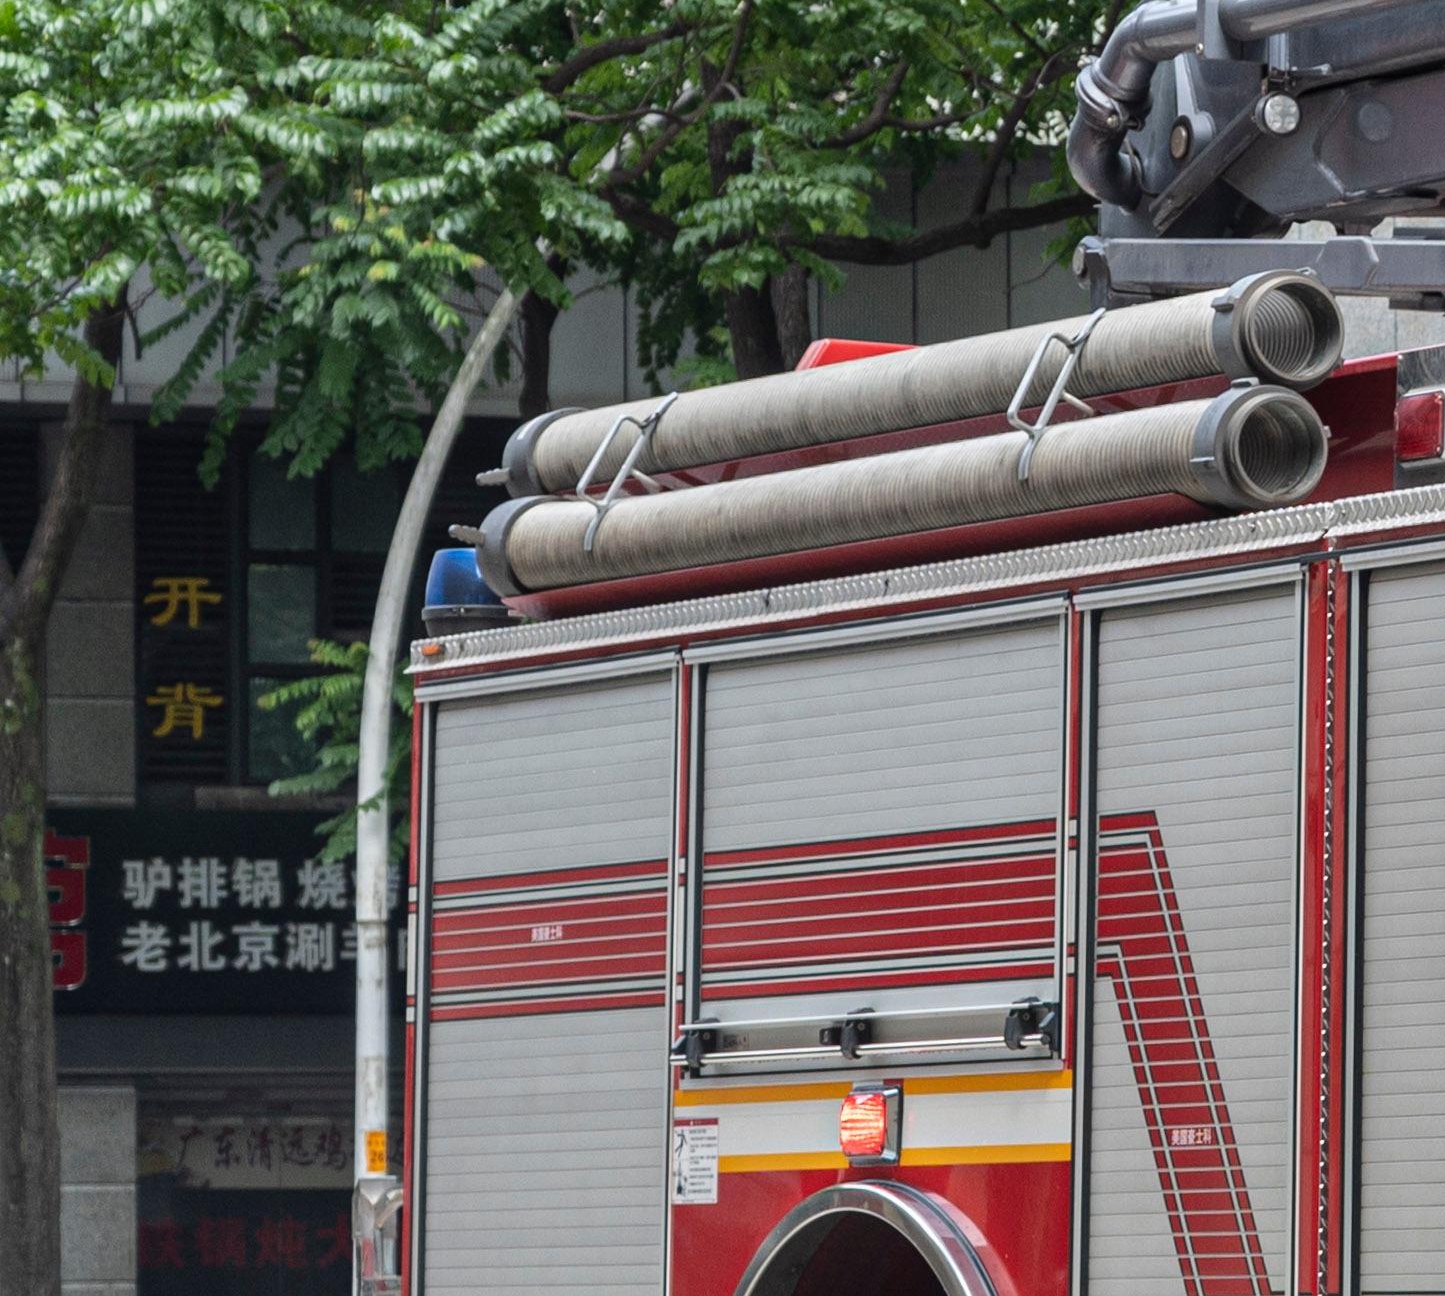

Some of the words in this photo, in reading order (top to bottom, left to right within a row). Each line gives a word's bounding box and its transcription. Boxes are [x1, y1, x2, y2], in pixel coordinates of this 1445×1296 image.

[143, 576, 224, 741] 开背
[122, 858, 282, 909] 驴排锅
[120, 920, 407, 973] 老北京涮
